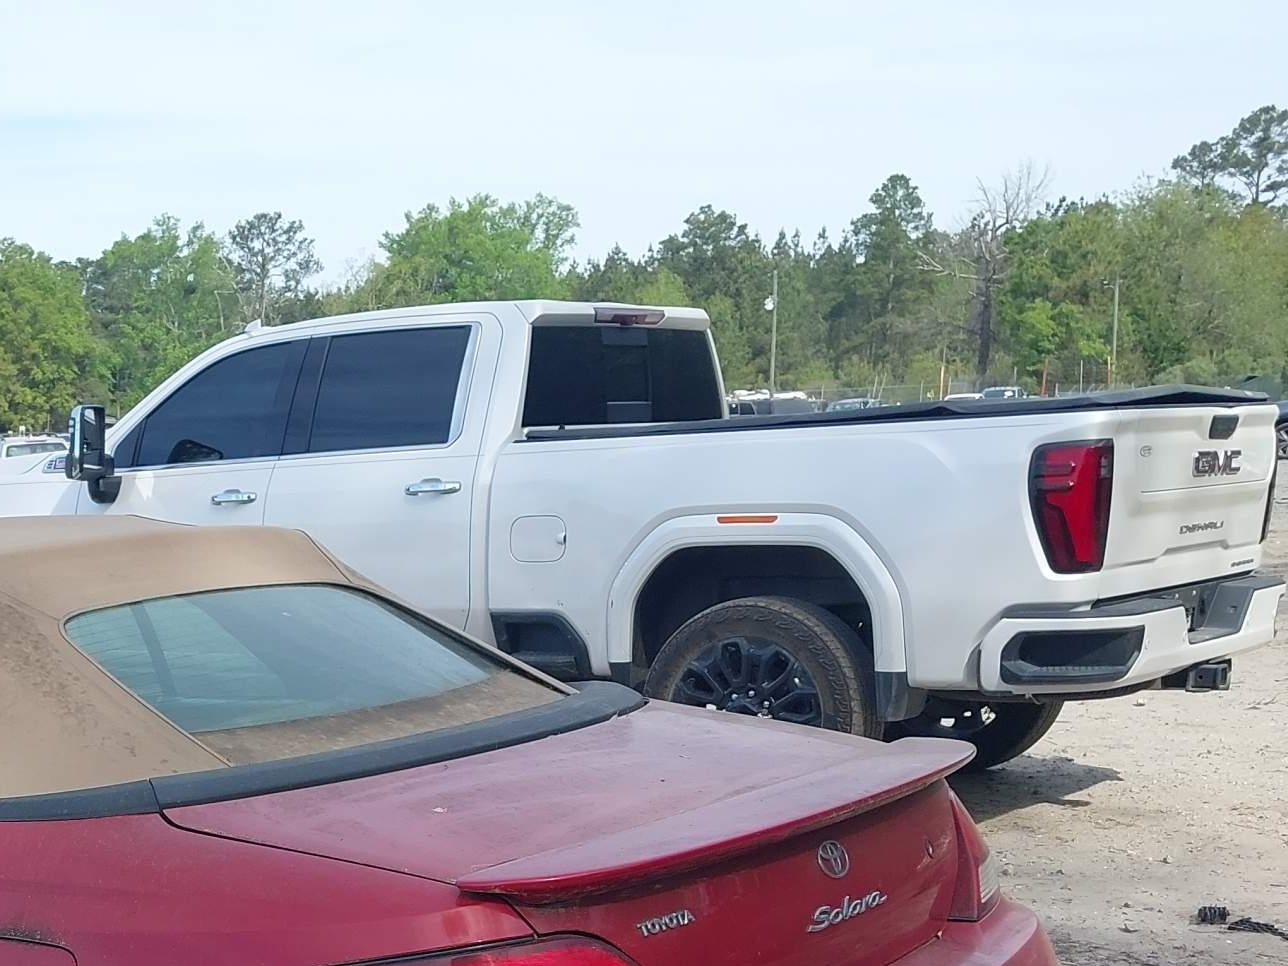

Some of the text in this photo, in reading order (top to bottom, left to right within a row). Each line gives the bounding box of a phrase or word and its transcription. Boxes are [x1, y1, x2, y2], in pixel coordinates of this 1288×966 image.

[1193, 449, 1242, 477] GMC
[1179, 521, 1224, 534] DENALI
[636, 909, 696, 937] TOYOTA
[807, 890, 888, 933] Solara
